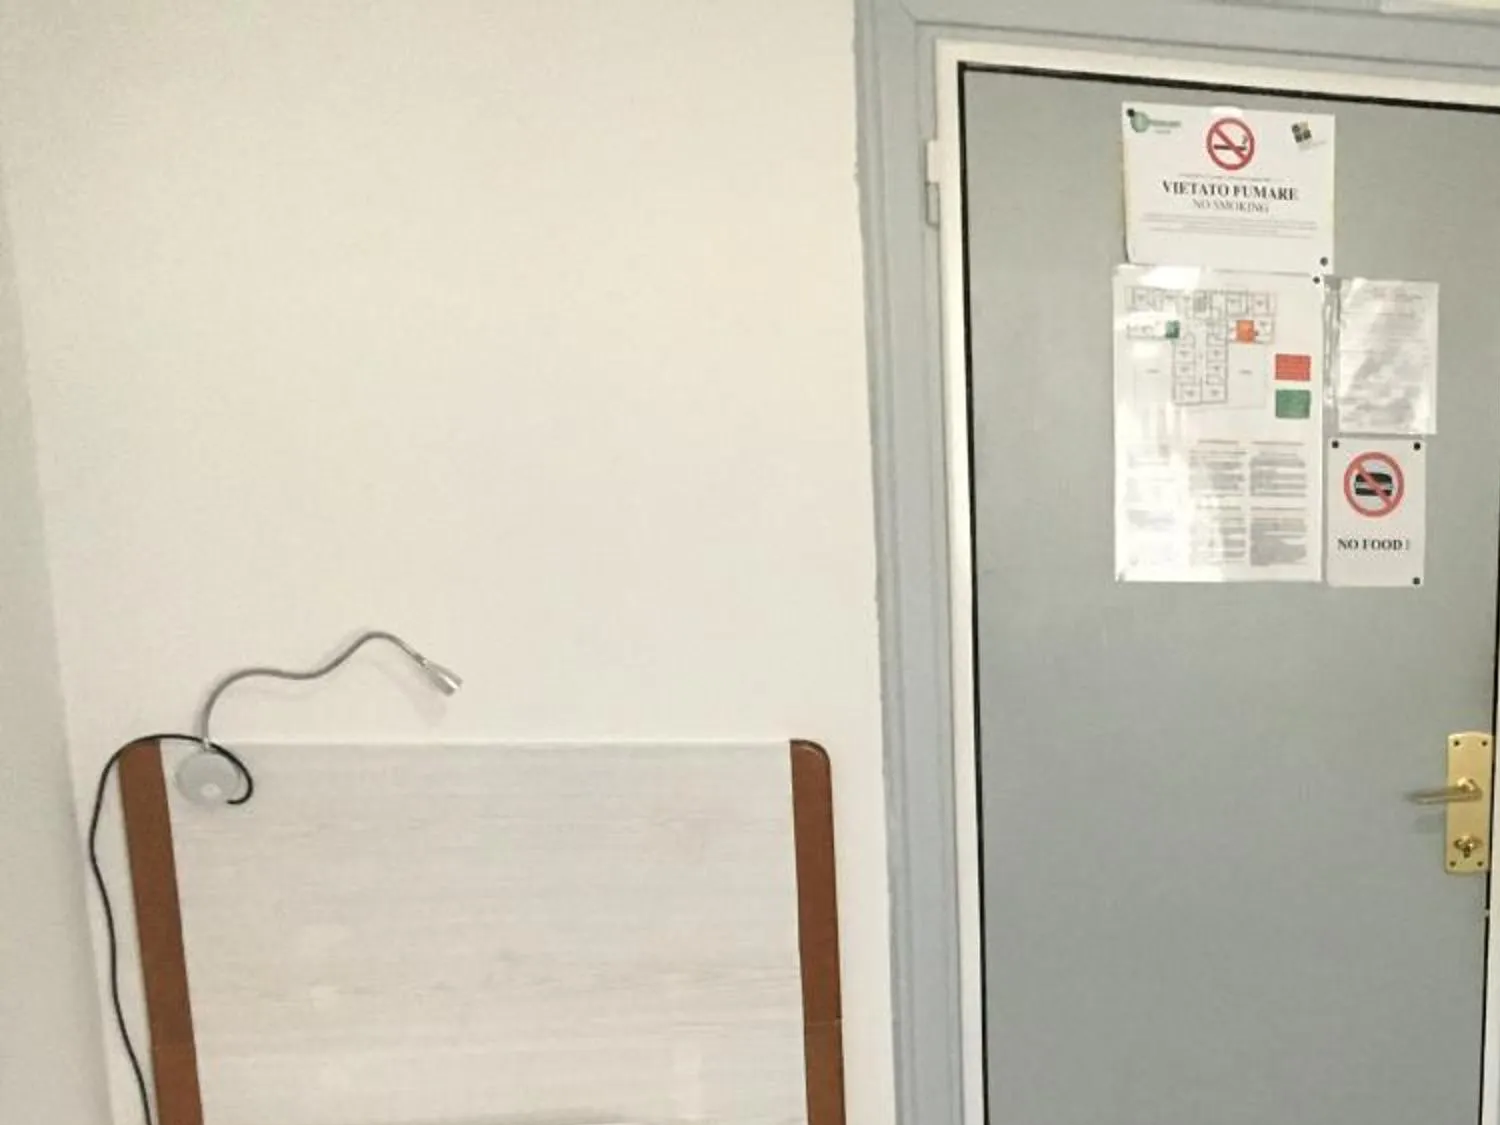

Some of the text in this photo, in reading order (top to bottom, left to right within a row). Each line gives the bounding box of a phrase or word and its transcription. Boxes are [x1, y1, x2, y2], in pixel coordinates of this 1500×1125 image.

[1162, 180, 1298, 201] VIETATO FUMARE
[1192, 198, 1270, 214] NO SMOKING
[1337, 538, 1359, 550] NO
[1362, 538, 1403, 550] FOOD
